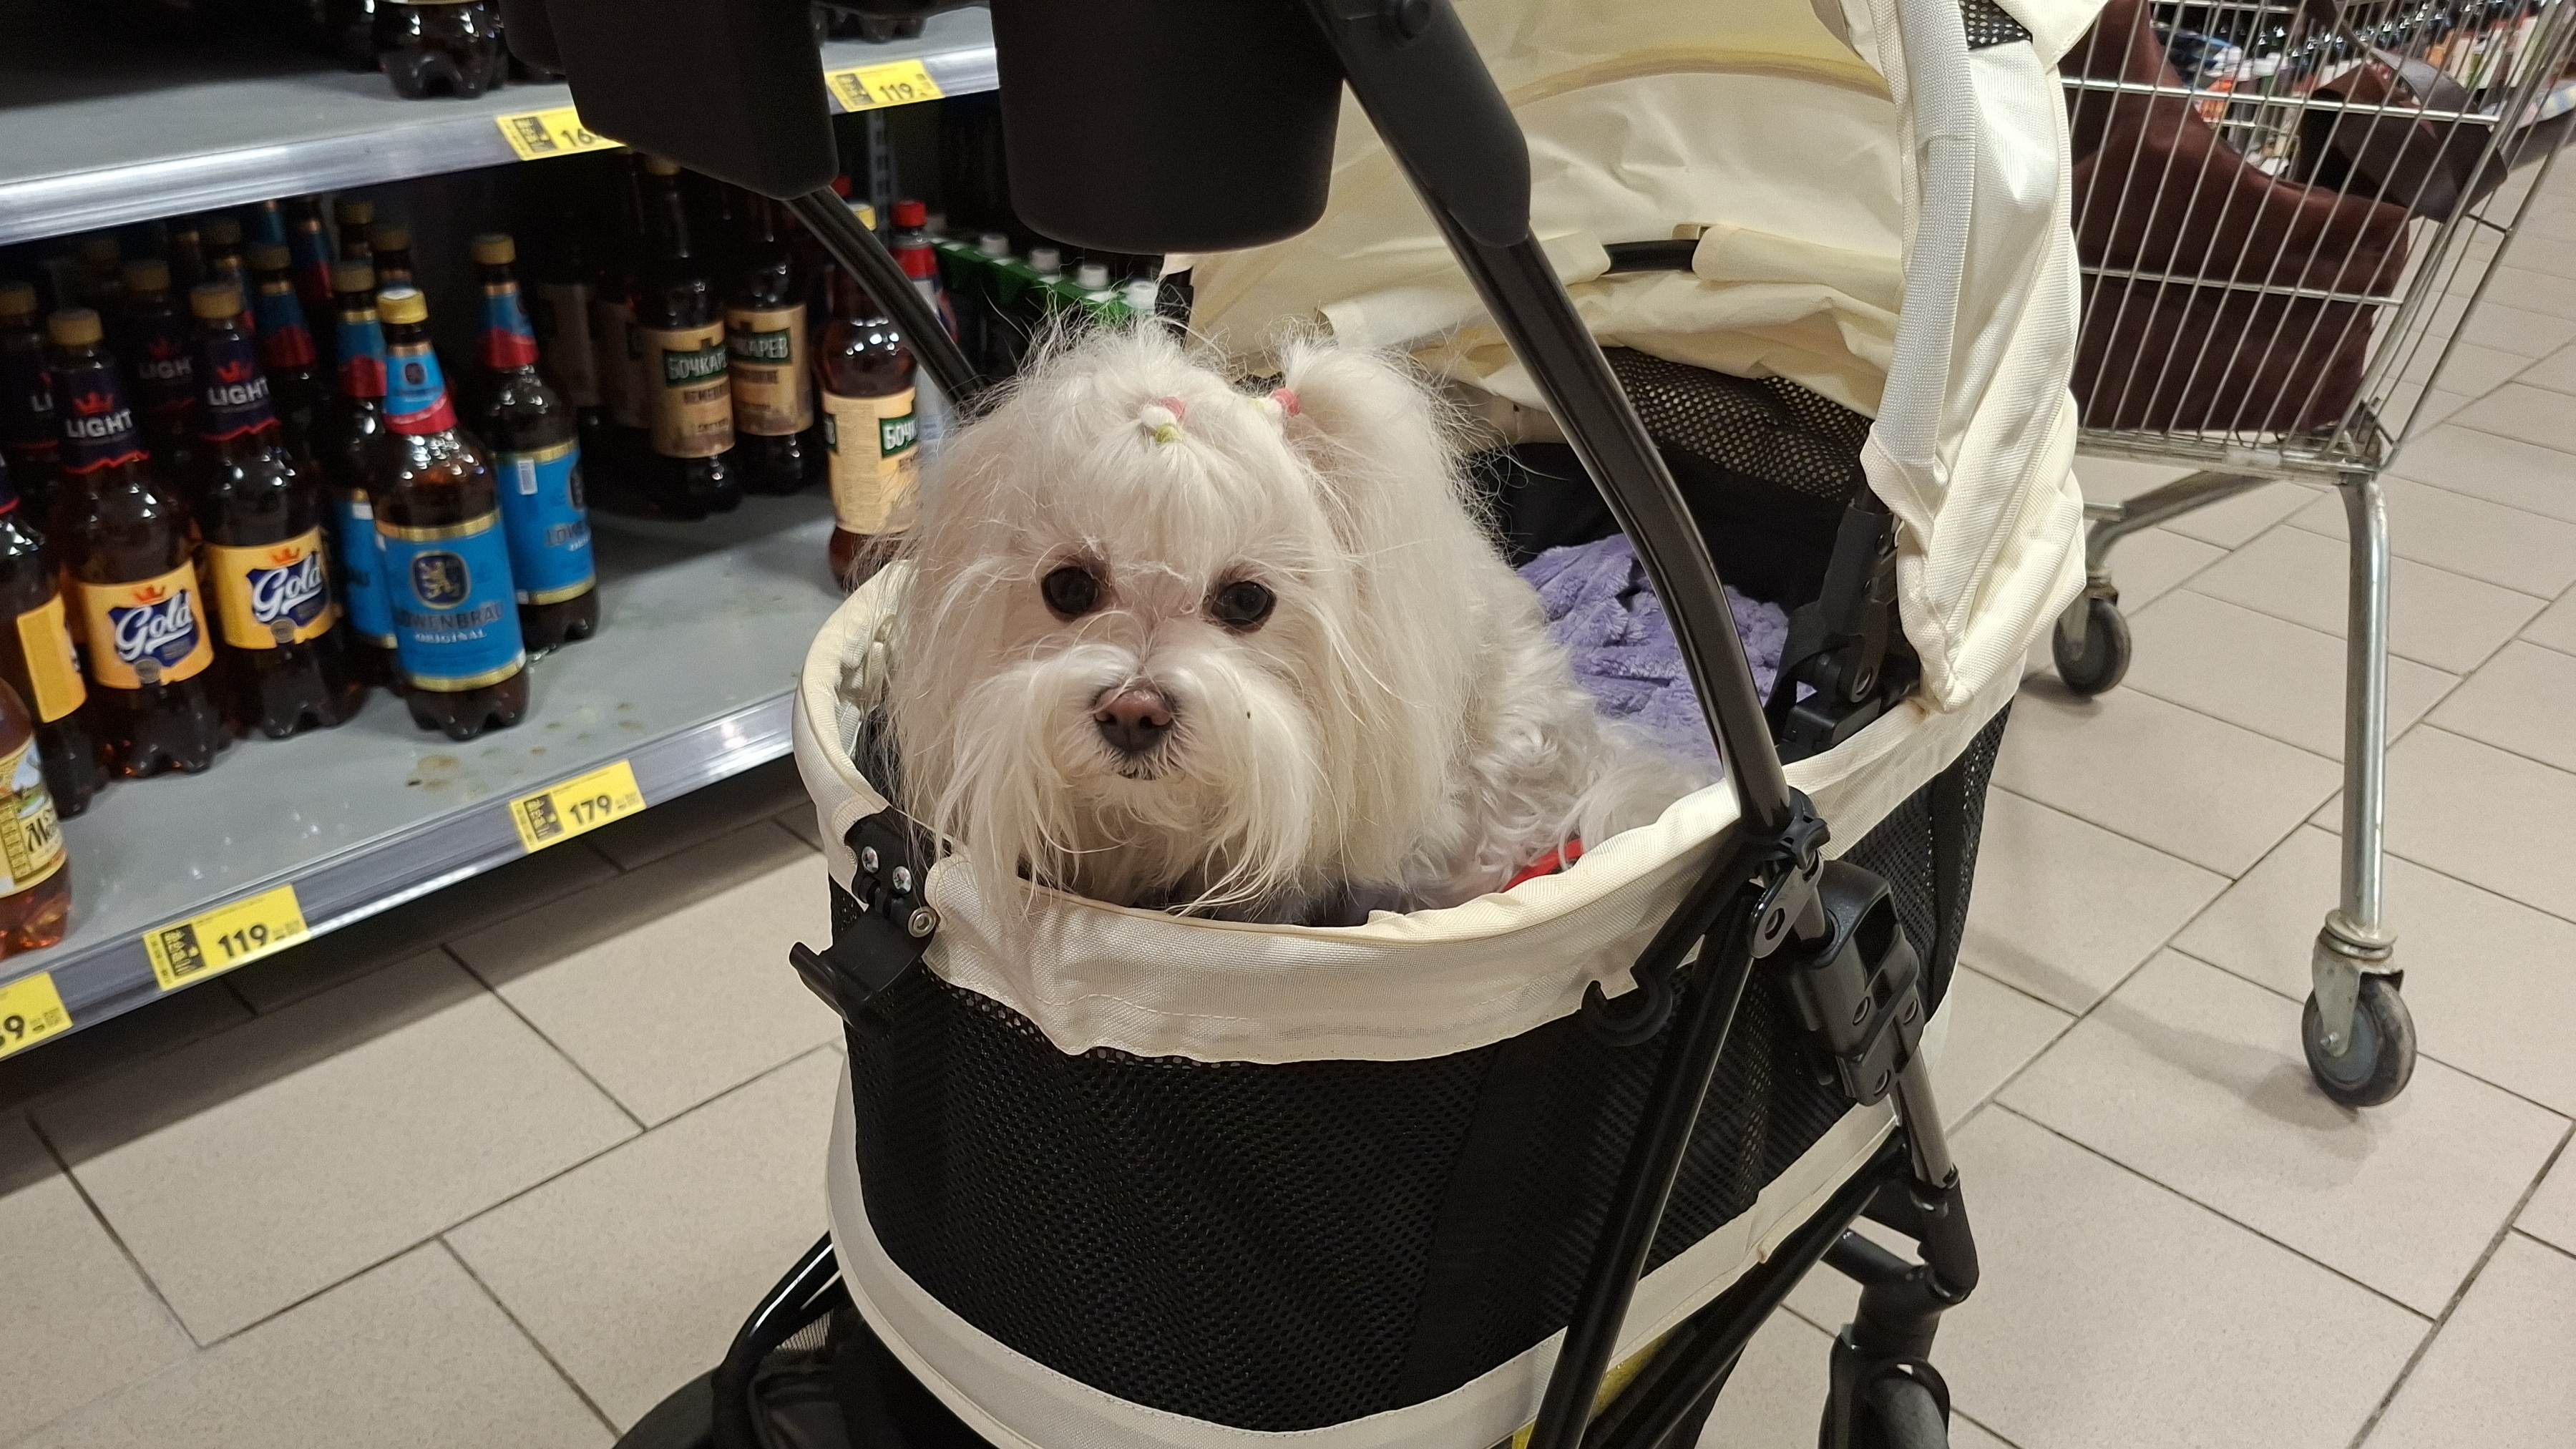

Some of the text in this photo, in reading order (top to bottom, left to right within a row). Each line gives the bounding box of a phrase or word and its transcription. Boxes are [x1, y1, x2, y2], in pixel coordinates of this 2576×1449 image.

[879, 82, 914, 102] 119
[561, 127, 604, 147] 16
[208, 376, 270, 406] LIGHT
[64, 407, 135, 439] LIGHT
[252, 550, 323, 623] Gold
[114, 588, 195, 663] Gold
[570, 795, 613, 826] 179
[218, 924, 269, 957] 119
